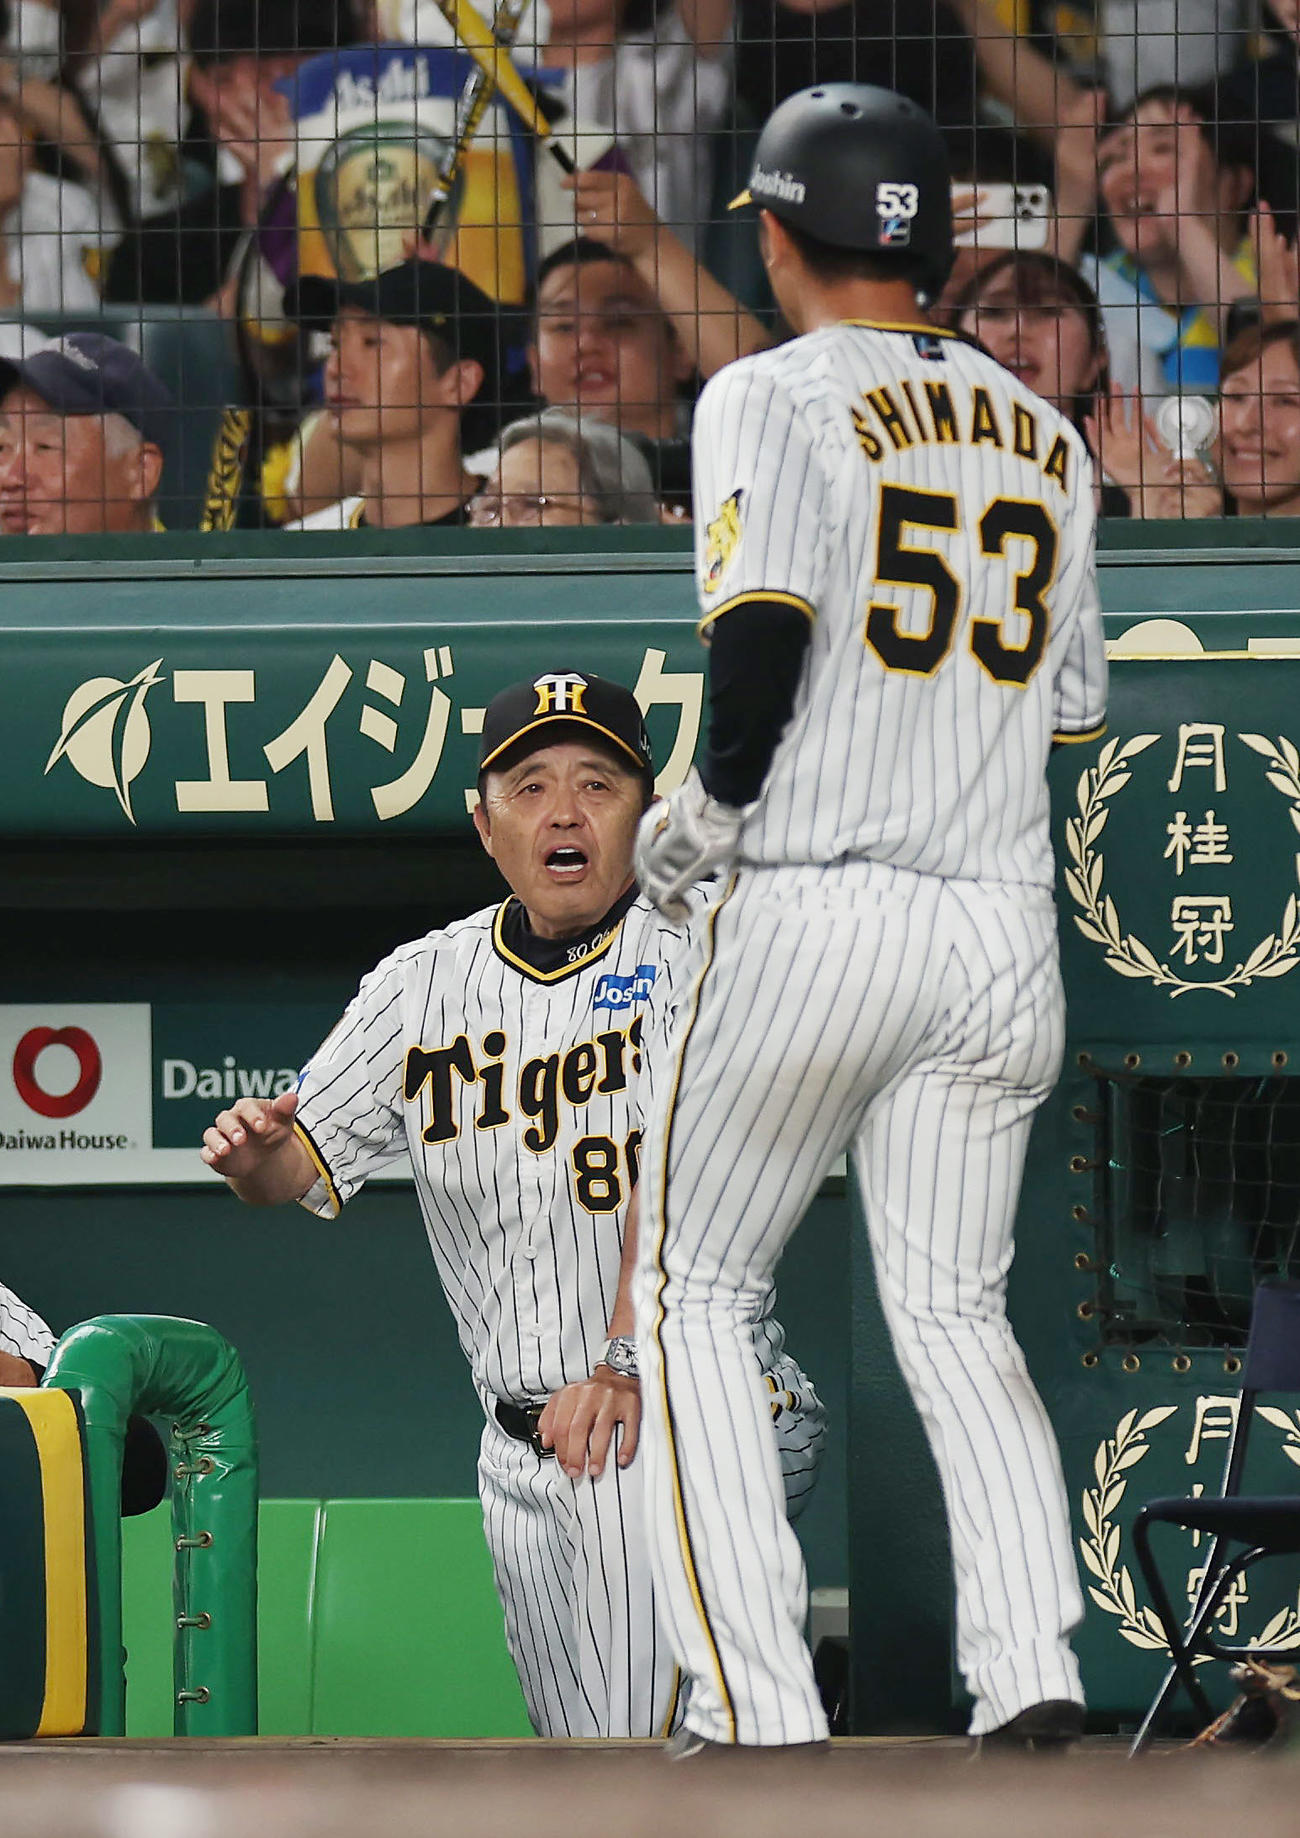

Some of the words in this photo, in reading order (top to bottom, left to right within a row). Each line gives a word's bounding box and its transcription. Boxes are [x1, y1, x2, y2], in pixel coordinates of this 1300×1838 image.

[876, 182, 919, 219] 53
[850, 379, 1070, 496] SHIMADA
[864, 481, 1060, 691] 53
[1164, 722, 1234, 964] 月桂冠
[163, 1056, 300, 1099] Daiwa
[60, 1129, 128, 1150] House
